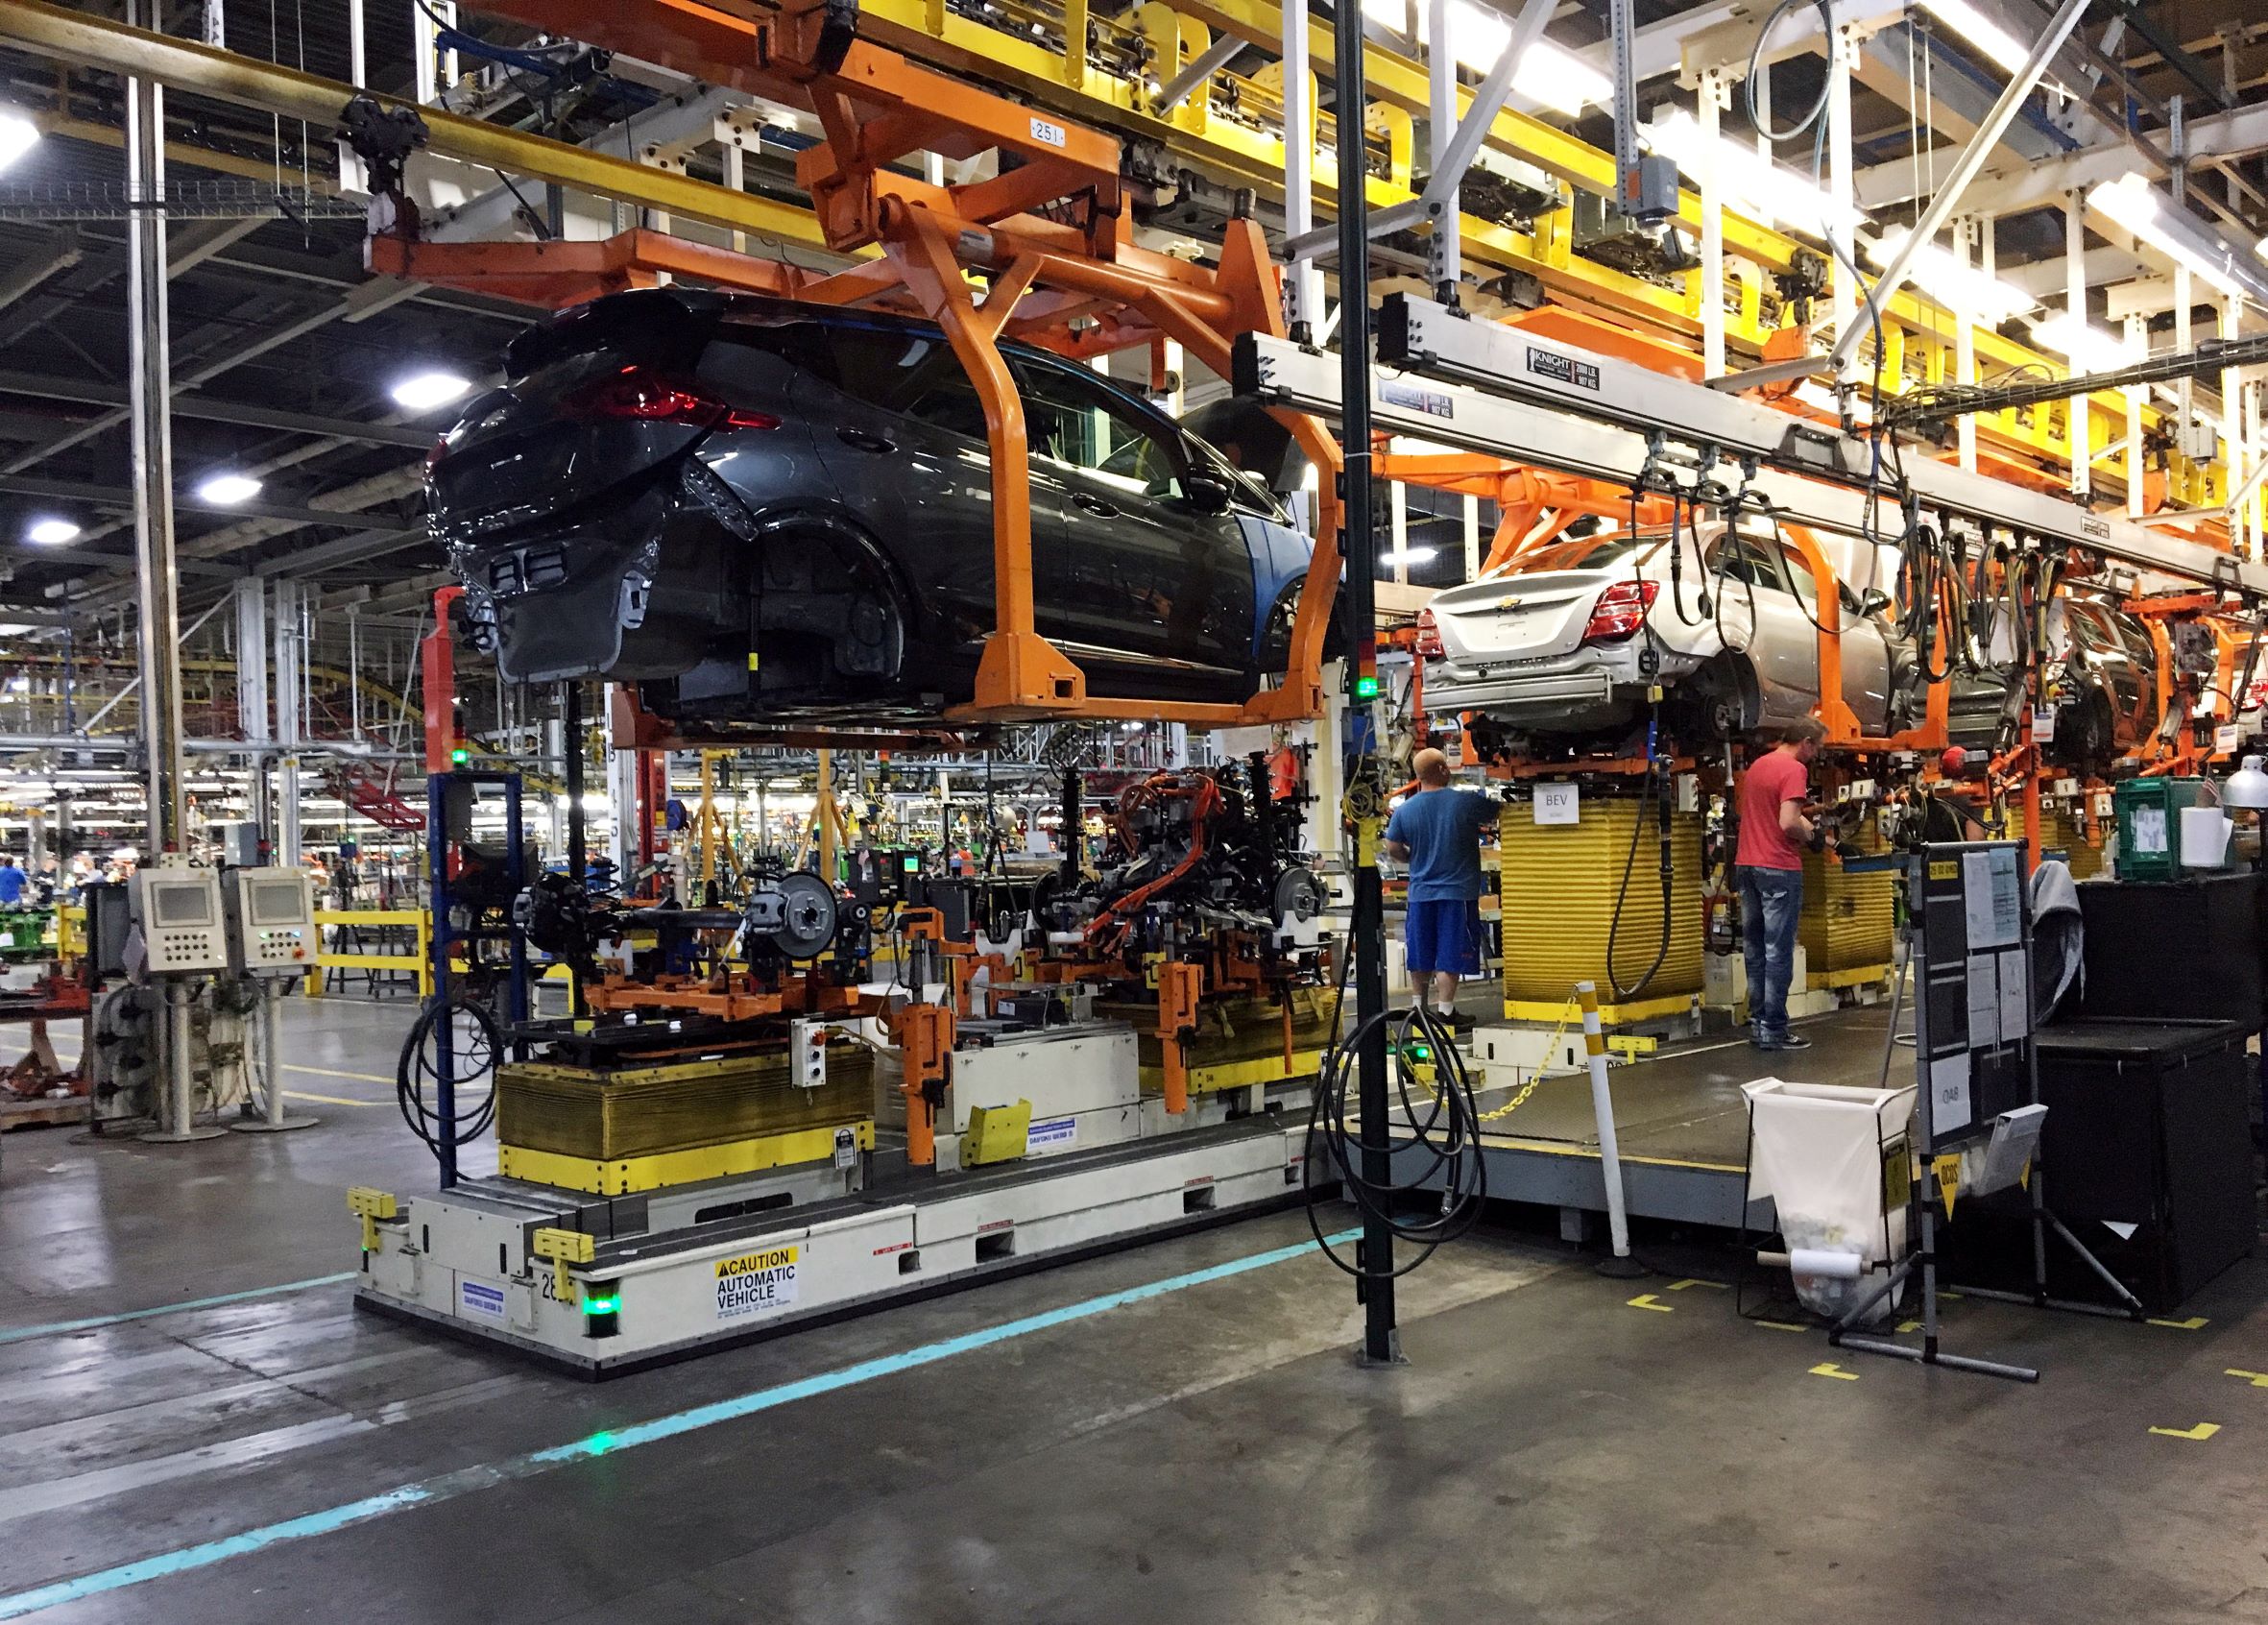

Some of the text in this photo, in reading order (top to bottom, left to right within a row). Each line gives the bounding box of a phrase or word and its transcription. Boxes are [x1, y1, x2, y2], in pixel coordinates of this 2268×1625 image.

[1036, 123, 1057, 142] 251
[1535, 350, 1571, 370] KNIGHT
[1546, 794, 1568, 806] BEV
[729, 1249, 789, 1275] CAUTION
[717, 1265, 795, 1296] AUTOMATIC
[717, 1285, 775, 1309] VEHICLE
